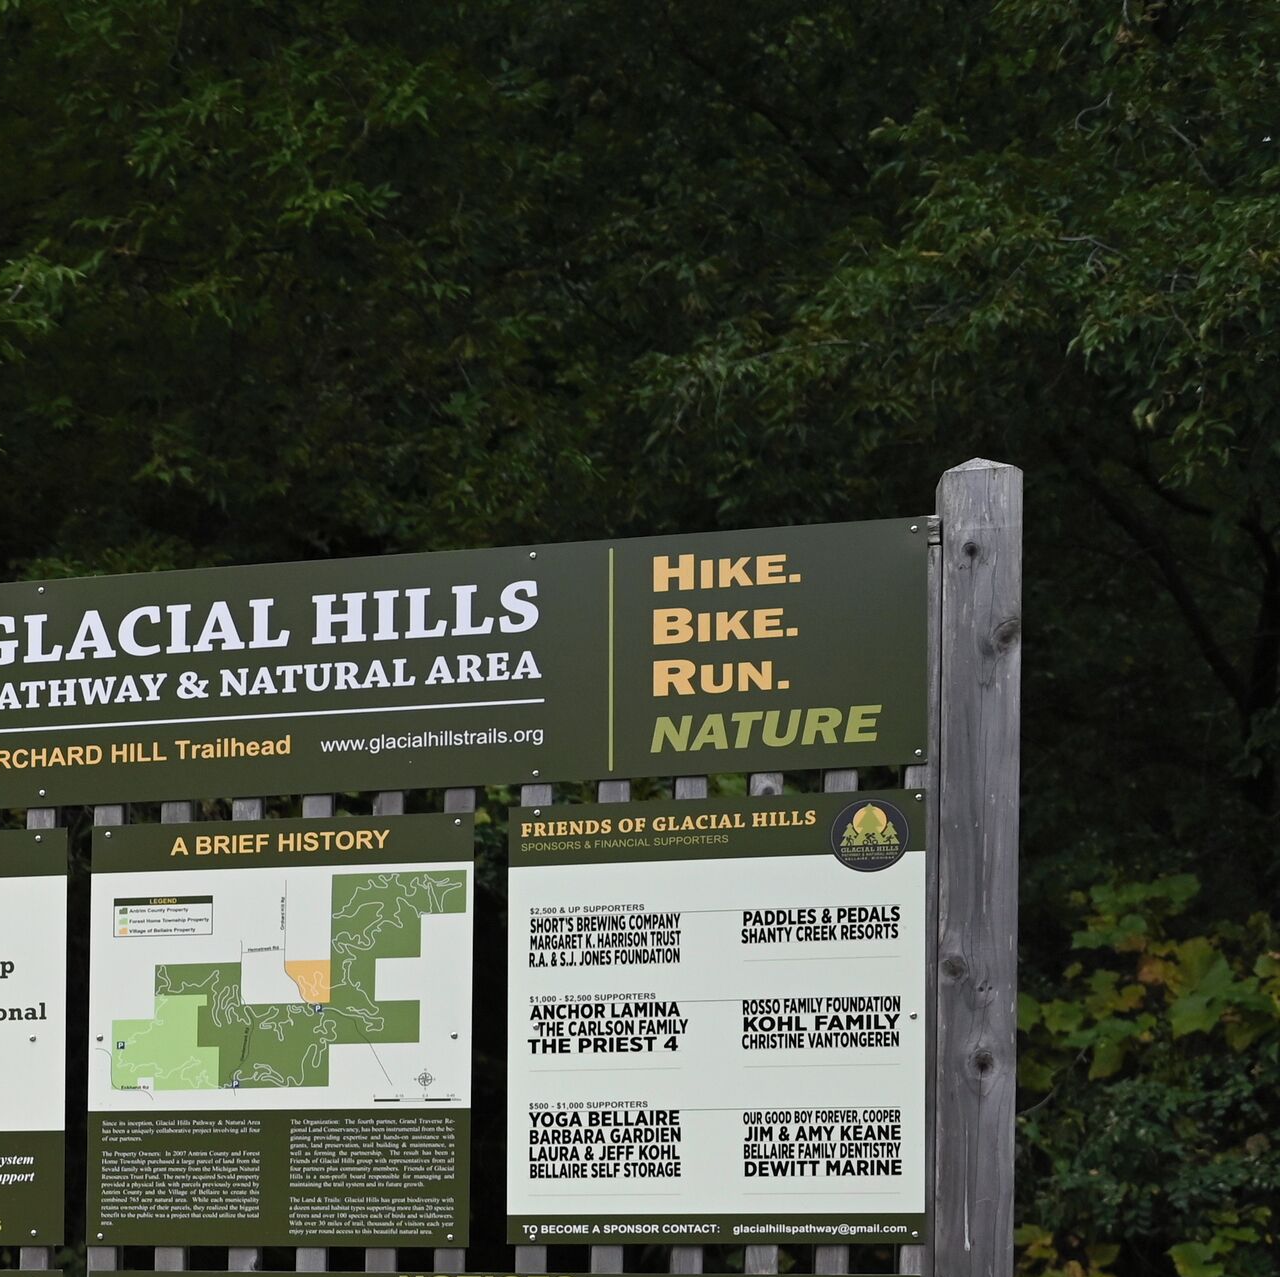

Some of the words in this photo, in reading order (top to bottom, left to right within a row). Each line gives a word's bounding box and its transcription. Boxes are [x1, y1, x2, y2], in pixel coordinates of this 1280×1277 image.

[312, 580, 539, 645] HILLS
[176, 671, 209, 699] &
[220, 658, 416, 697] NATURAL
[425, 650, 542, 685] AREA
[650, 704, 882, 753] NATURE
[111, 742, 167, 763] HILL
[175, 734, 290, 760] Trailhead
[320, 728, 543, 754] www.glacialhillstrails.org
[521, 819, 611, 837] FRIENDS
[618, 818, 646, 833] OF
[652, 813, 745, 831] GLACIAL
[752, 810, 816, 827] HILLS
[170, 837, 189, 856] A
[196, 834, 269, 855] BRIEF
[278, 829, 390, 852] HISTORY
[521, 841, 581, 852] SPONSORS
[584, 840, 591, 849] &
[594, 838, 650, 848] FINANCIAL
[653, 834, 729, 846] SUPPORTERS
[577, 915, 626, 932] BREWING
[629, 913, 681, 930] COMPANY
[743, 908, 817, 927] PADDLES
[821, 908, 832, 924] &
[837, 905, 900, 924] PEDALS
[527, 1038, 571, 1054] THE
[578, 1036, 657, 1053] PRIEST
[663, 1036, 679, 1052] 4
[529, 1111, 582, 1128] YOGA
[588, 1109, 680, 1127] BELLAIRE
[733, 1224, 907, 1235] glacialhillspathway@gmail.com
